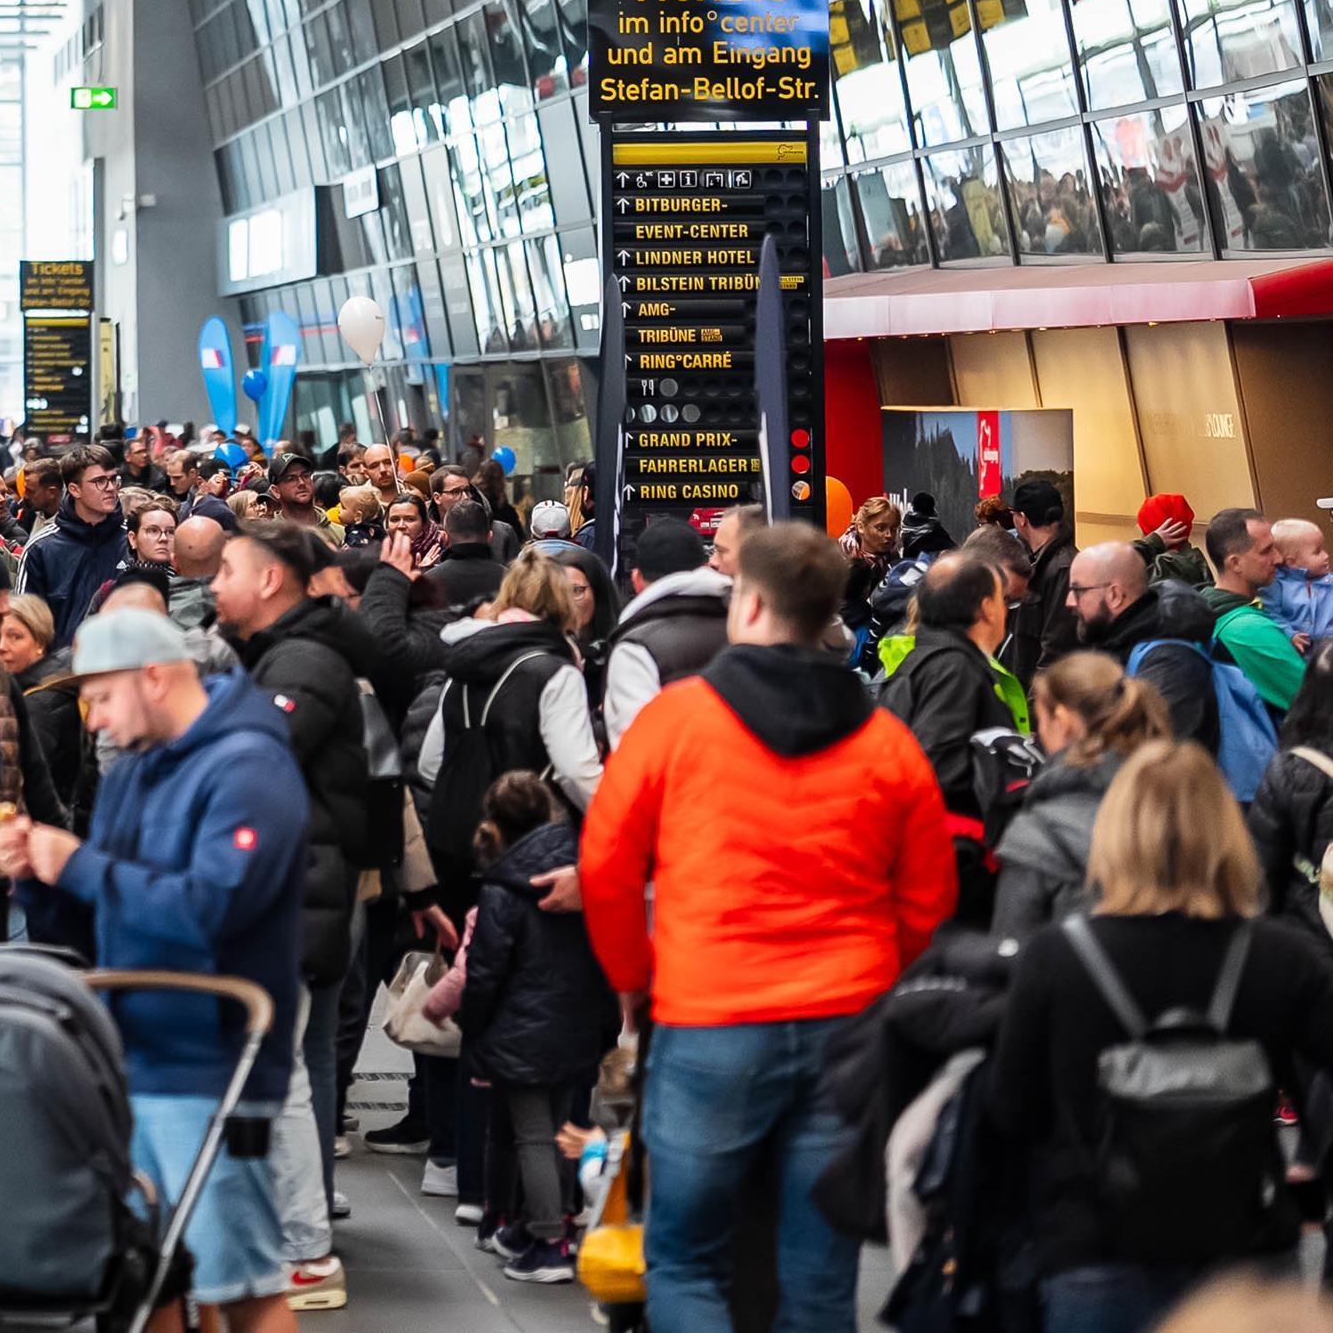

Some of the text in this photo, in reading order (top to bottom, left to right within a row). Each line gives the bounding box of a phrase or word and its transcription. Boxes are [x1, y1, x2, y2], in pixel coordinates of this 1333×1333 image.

[619, 11, 649, 34] im
[607, 41, 811, 68] und am Eingang
[600, 77, 819, 100] Stefan-Bellof-Str.
[635, 198, 728, 212] BITBURGER-
[636, 224, 748, 239] EVENT-CENTER
[636, 249, 755, 265] LINDNER HOTEL
[30, 262, 83, 275] Tickets
[636, 273, 761, 291] BILSTEIN TRIBÜN
[638, 303, 676, 318] AMG-
[638, 327, 696, 343] TRIBÜNE
[639, 433, 737, 448] GRAND PRIX-
[639, 458, 747, 472] FAHRERLAGER
[640, 483, 739, 499] RING CASINO
